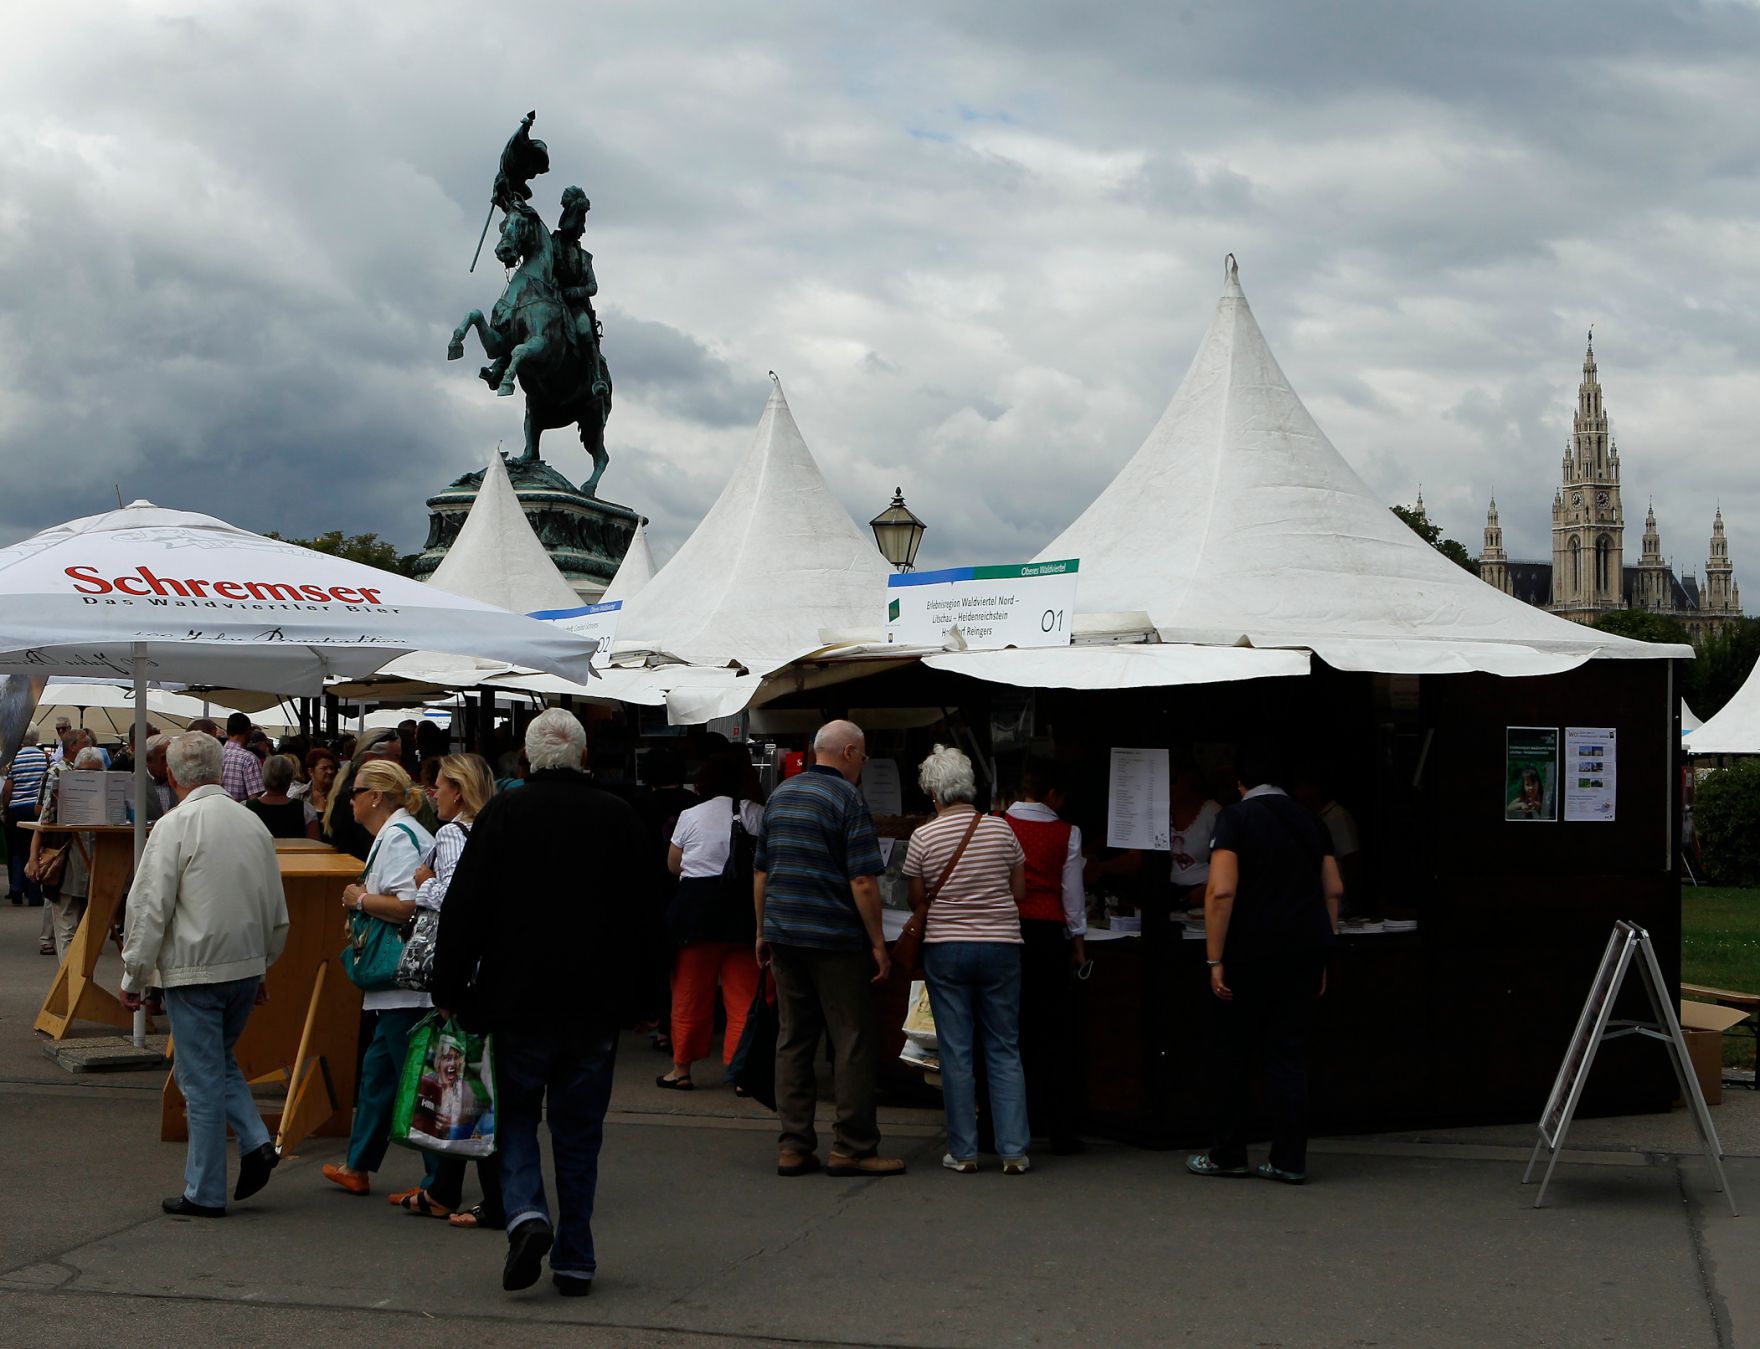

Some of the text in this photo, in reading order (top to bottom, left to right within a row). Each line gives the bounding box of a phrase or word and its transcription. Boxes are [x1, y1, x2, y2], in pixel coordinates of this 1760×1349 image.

[1021, 566, 1040, 576] Oberes
[64, 566, 382, 604] Schremser
[82, 596, 401, 615] Das Waldviertler Bier
[926, 599, 960, 611] Erlebnisregion
[962, 596, 997, 607] Waldviertel
[999, 595, 1015, 606] Nord
[958, 610, 1008, 622] Heidenreichstein
[1041, 609, 1064, 633] 01
[967, 626, 993, 638] Reingers
[596, 636, 611, 653] 02
